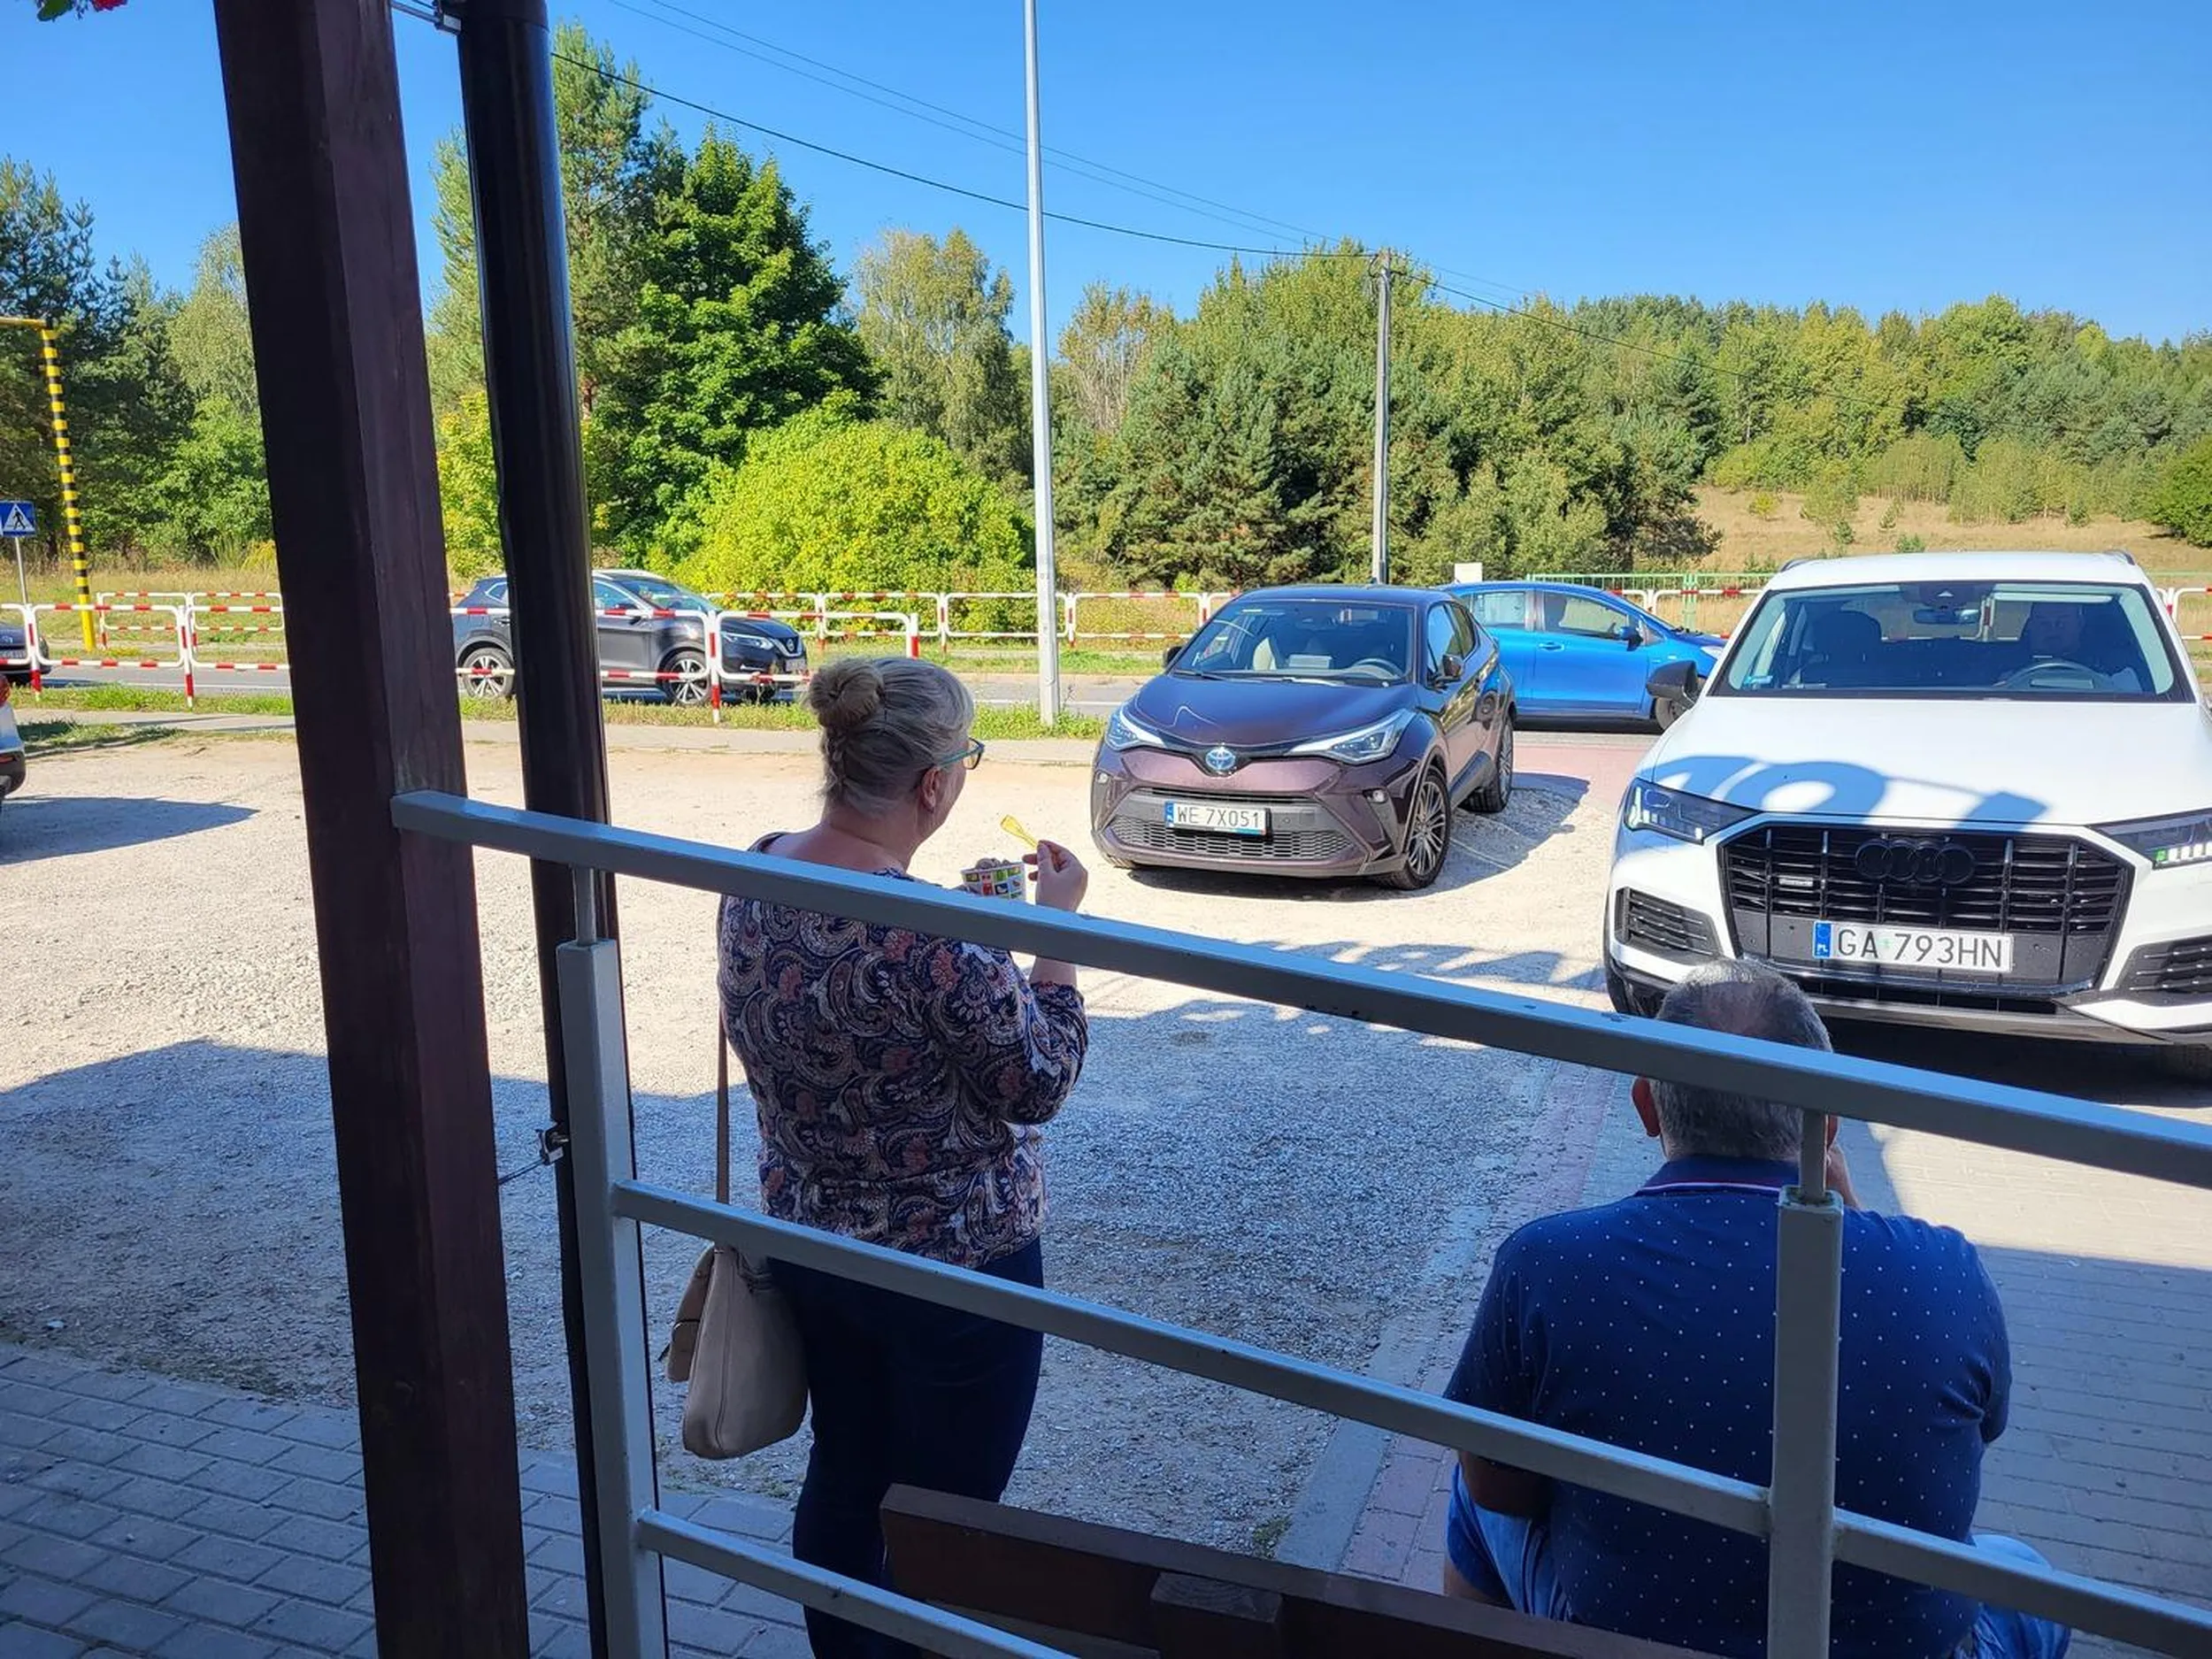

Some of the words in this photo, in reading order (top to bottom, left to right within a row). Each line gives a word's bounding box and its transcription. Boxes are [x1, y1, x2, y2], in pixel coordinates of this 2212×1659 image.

[1177, 806, 1200, 824] WE
[1838, 929, 1878, 959] GA
[1894, 933, 2001, 968] 793HN
